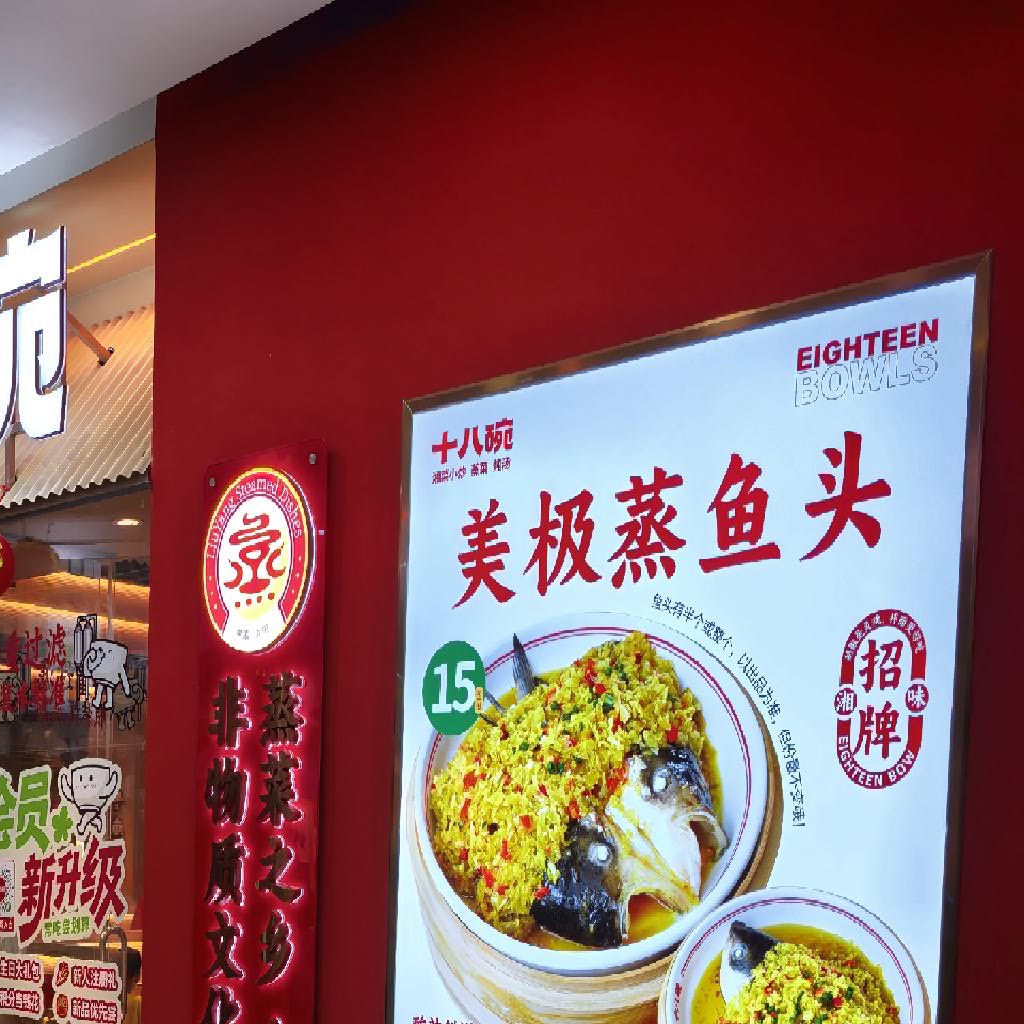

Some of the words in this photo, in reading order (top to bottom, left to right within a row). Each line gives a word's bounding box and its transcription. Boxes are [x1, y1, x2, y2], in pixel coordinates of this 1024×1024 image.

[797, 319, 939, 371] EIGHTEEN
[795, 346, 939, 407] BOWLS
[432, 417, 513, 464] 十八碗
[235, 478, 278, 496] Steamed
[278, 483, 302, 538] Dishes
[452, 430, 892, 609] 美极蒸鱼头
[432, 661, 476, 713] 15
[837, 691, 855, 712] 湘
[908, 686, 925, 708] 味
[852, 640, 903, 759] 招牌
[838, 736, 883, 787] EIGHTEEN
[888, 750, 916, 782] BOW
[17, 835, 125, 943] 新升级
[0, 959, 40, 982] 生日大礼包
